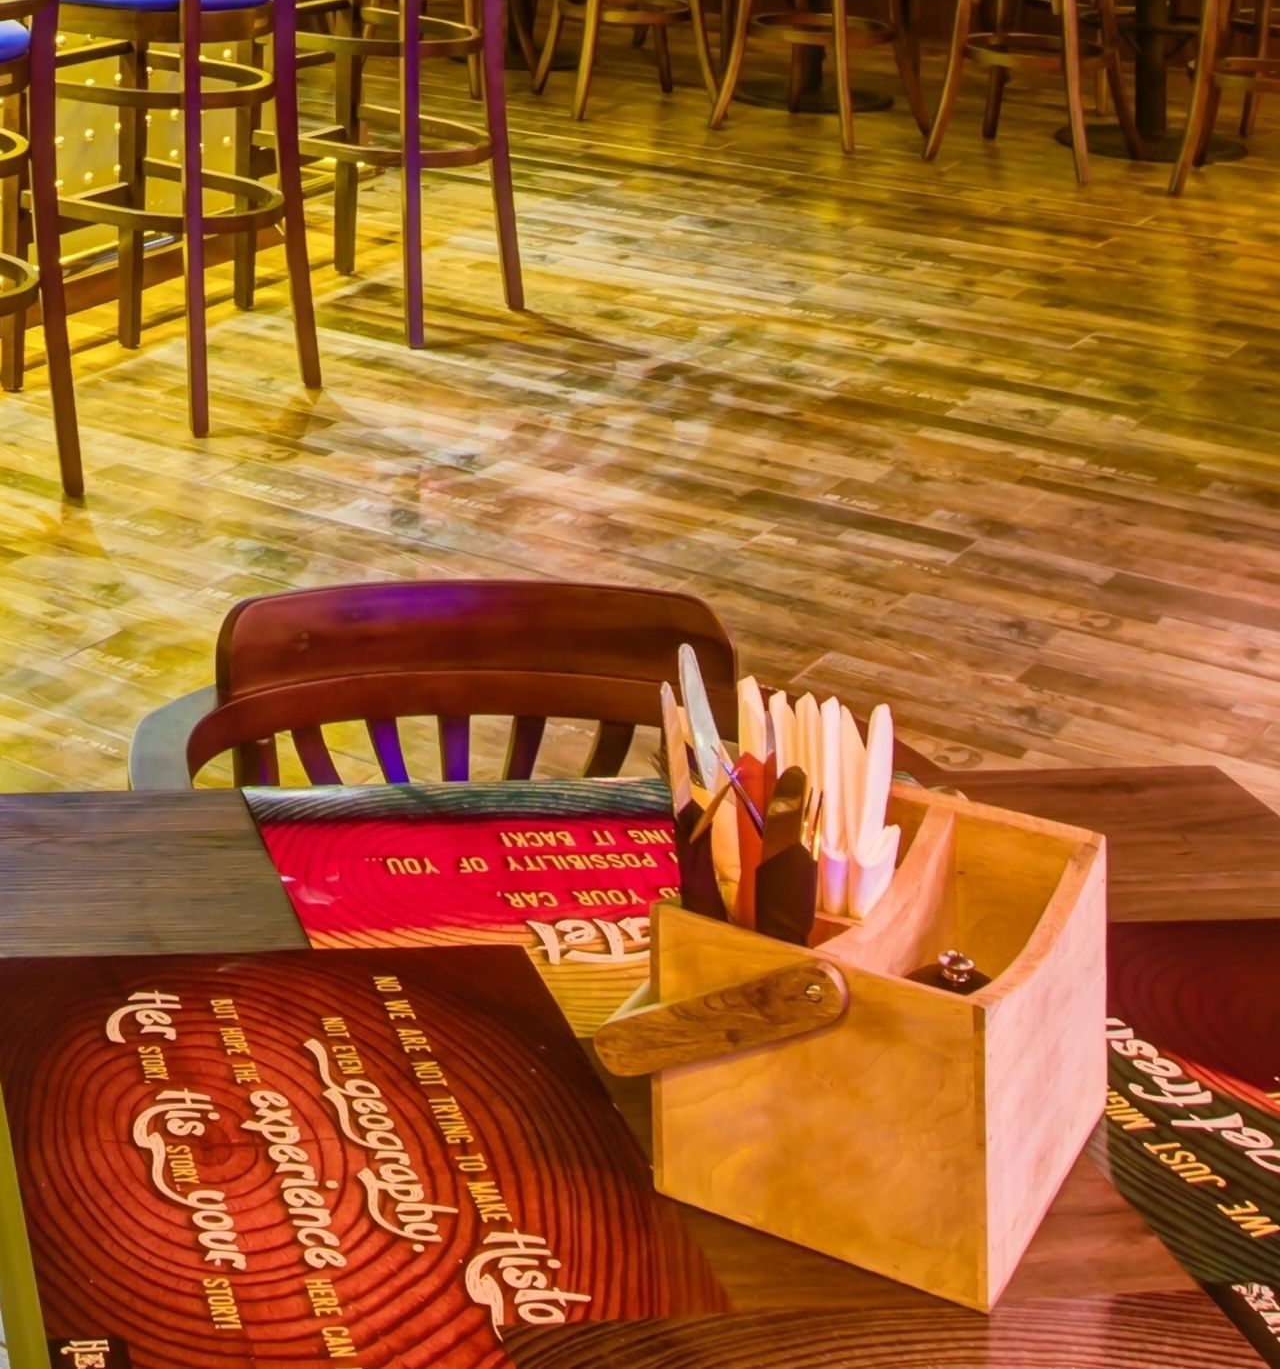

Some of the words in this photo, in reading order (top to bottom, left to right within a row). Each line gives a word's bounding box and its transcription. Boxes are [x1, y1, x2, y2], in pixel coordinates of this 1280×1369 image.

[499, 831, 577, 848] BACK!
[592, 830, 617, 846] IT
[364, 856, 441, 876] YOU...
[459, 855, 489, 874] OF
[506, 852, 658, 872] POSSIBILITY
[572, 888, 647, 907] YOUR
[373, 976, 402, 992] NO
[106, 990, 183, 1044] Her
[210, 999, 239, 1020] BUT
[384, 999, 416, 1020] WE
[321, 1017, 351, 1038] NOT
[219, 1027, 251, 1055] HOPE
[396, 1028, 431, 1053] ARE
[232, 1061, 261, 1084] THE
[331, 1045, 365, 1075] EVEN
[412, 1061, 448, 1085] NOT
[133, 1088, 221, 1150] His
[428, 1096, 474, 1144] TRYING
[1105, 1085, 1157, 1131] MIG
[455, 1153, 488, 1172] TO
[1143, 1142, 1227, 1188] JUST
[240, 1090, 347, 1269] experience
[467, 1181, 513, 1223] MAKE
[1217, 1200, 1280, 1238] WE
[202, 1277, 243, 1330] STORY!
[305, 1278, 343, 1318] HERE
[321, 1326, 358, 1358] CAN
